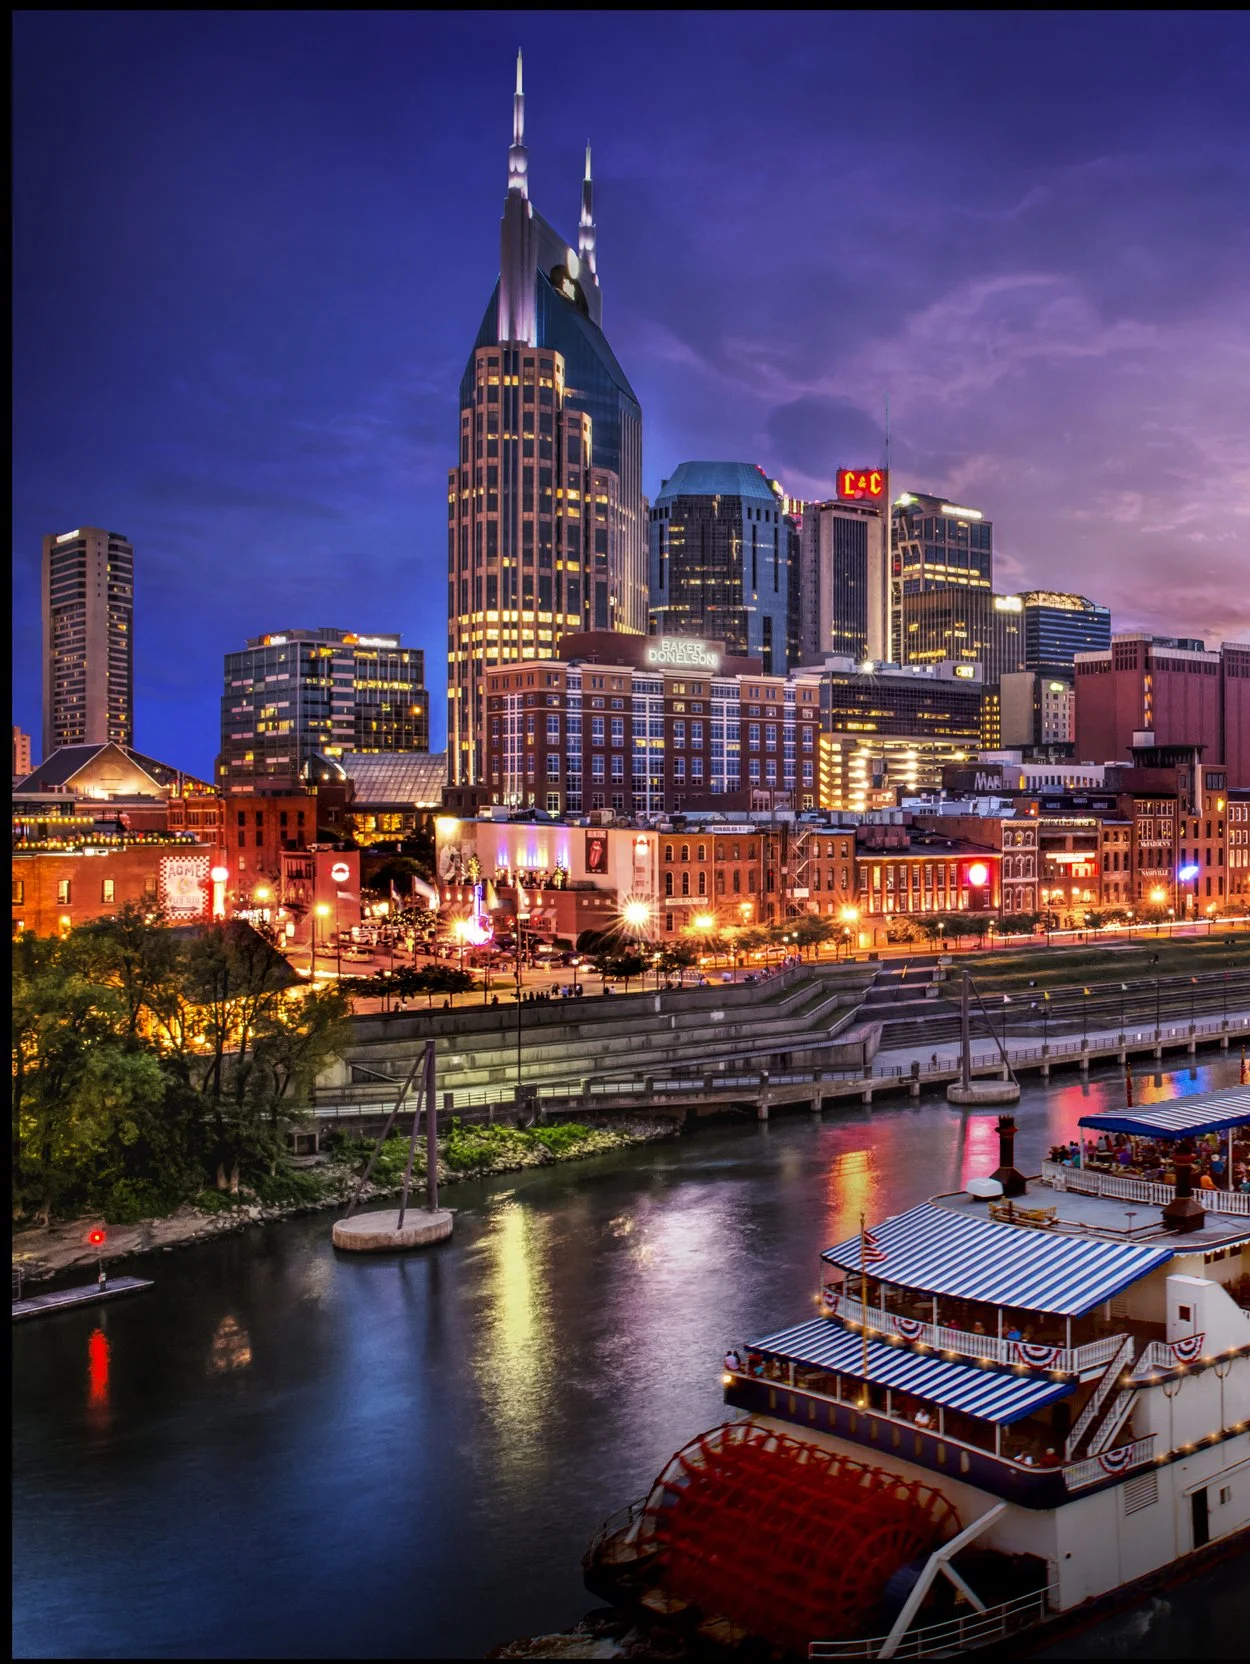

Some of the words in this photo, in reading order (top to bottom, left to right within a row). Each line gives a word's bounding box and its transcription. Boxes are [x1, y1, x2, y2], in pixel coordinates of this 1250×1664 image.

[661, 640, 703, 654] BAKER
[648, 650, 717, 666] DONELSON
[168, 864, 201, 878] ACME
